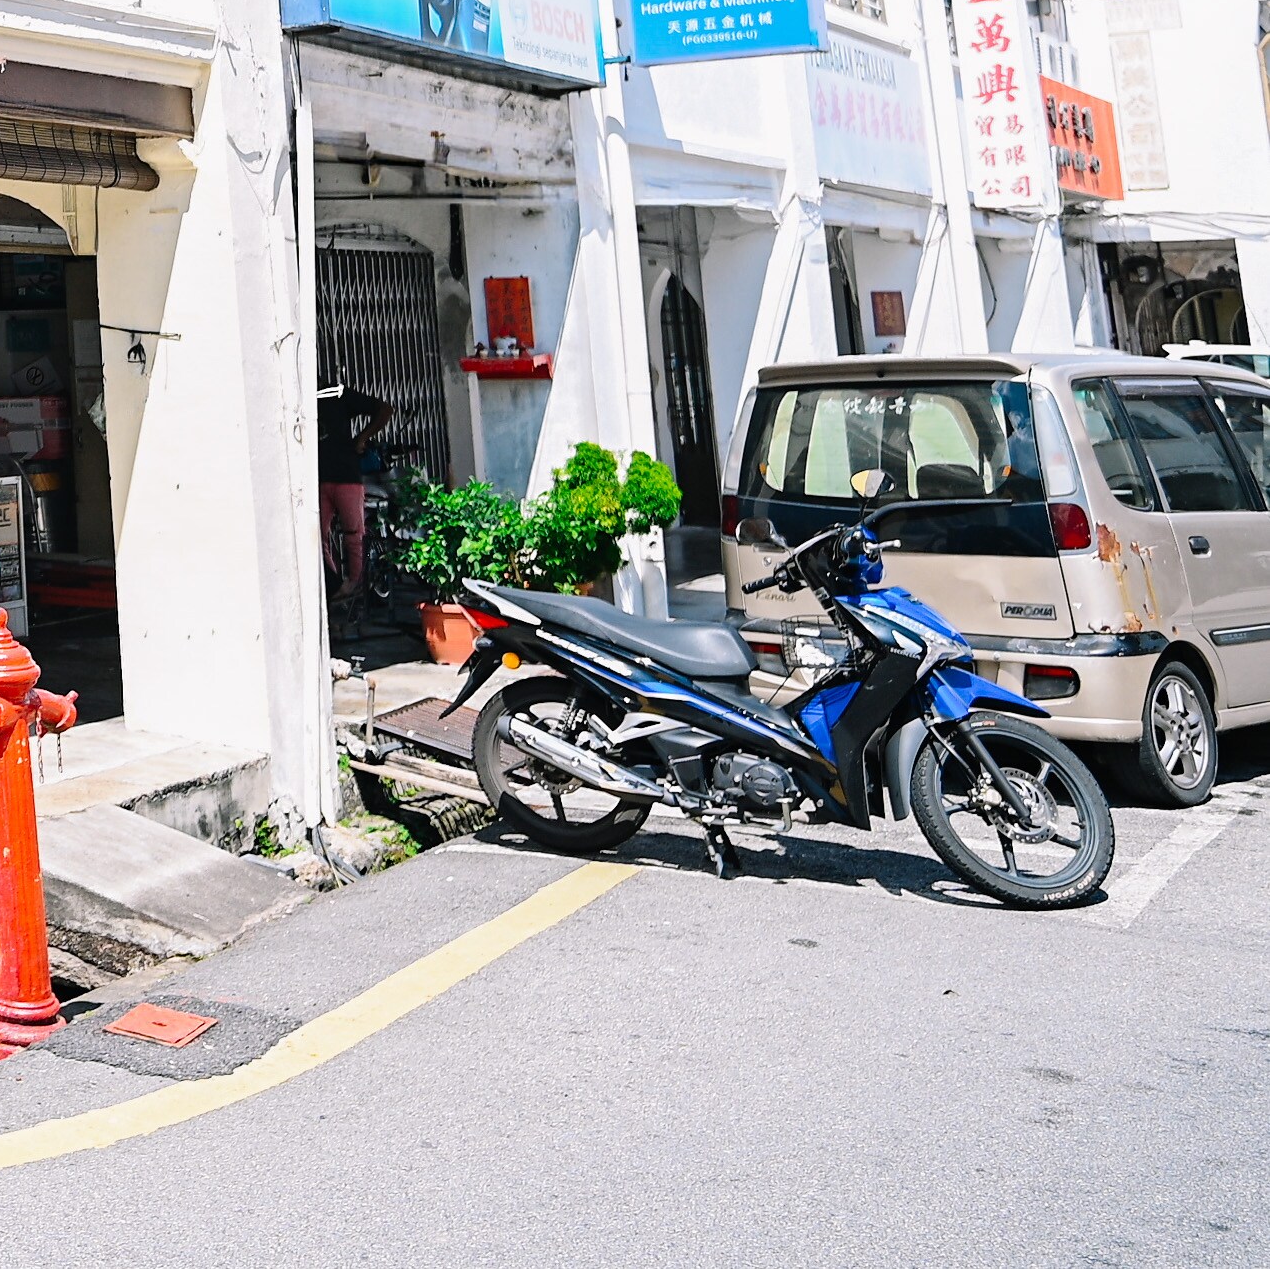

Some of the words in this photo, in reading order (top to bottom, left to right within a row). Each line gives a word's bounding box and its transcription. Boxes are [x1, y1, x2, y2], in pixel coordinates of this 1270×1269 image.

[531, 0, 586, 44] BOSCH
[1004, 605, 1053, 617] PERODUA
[890, 646, 921, 660] HONDA
